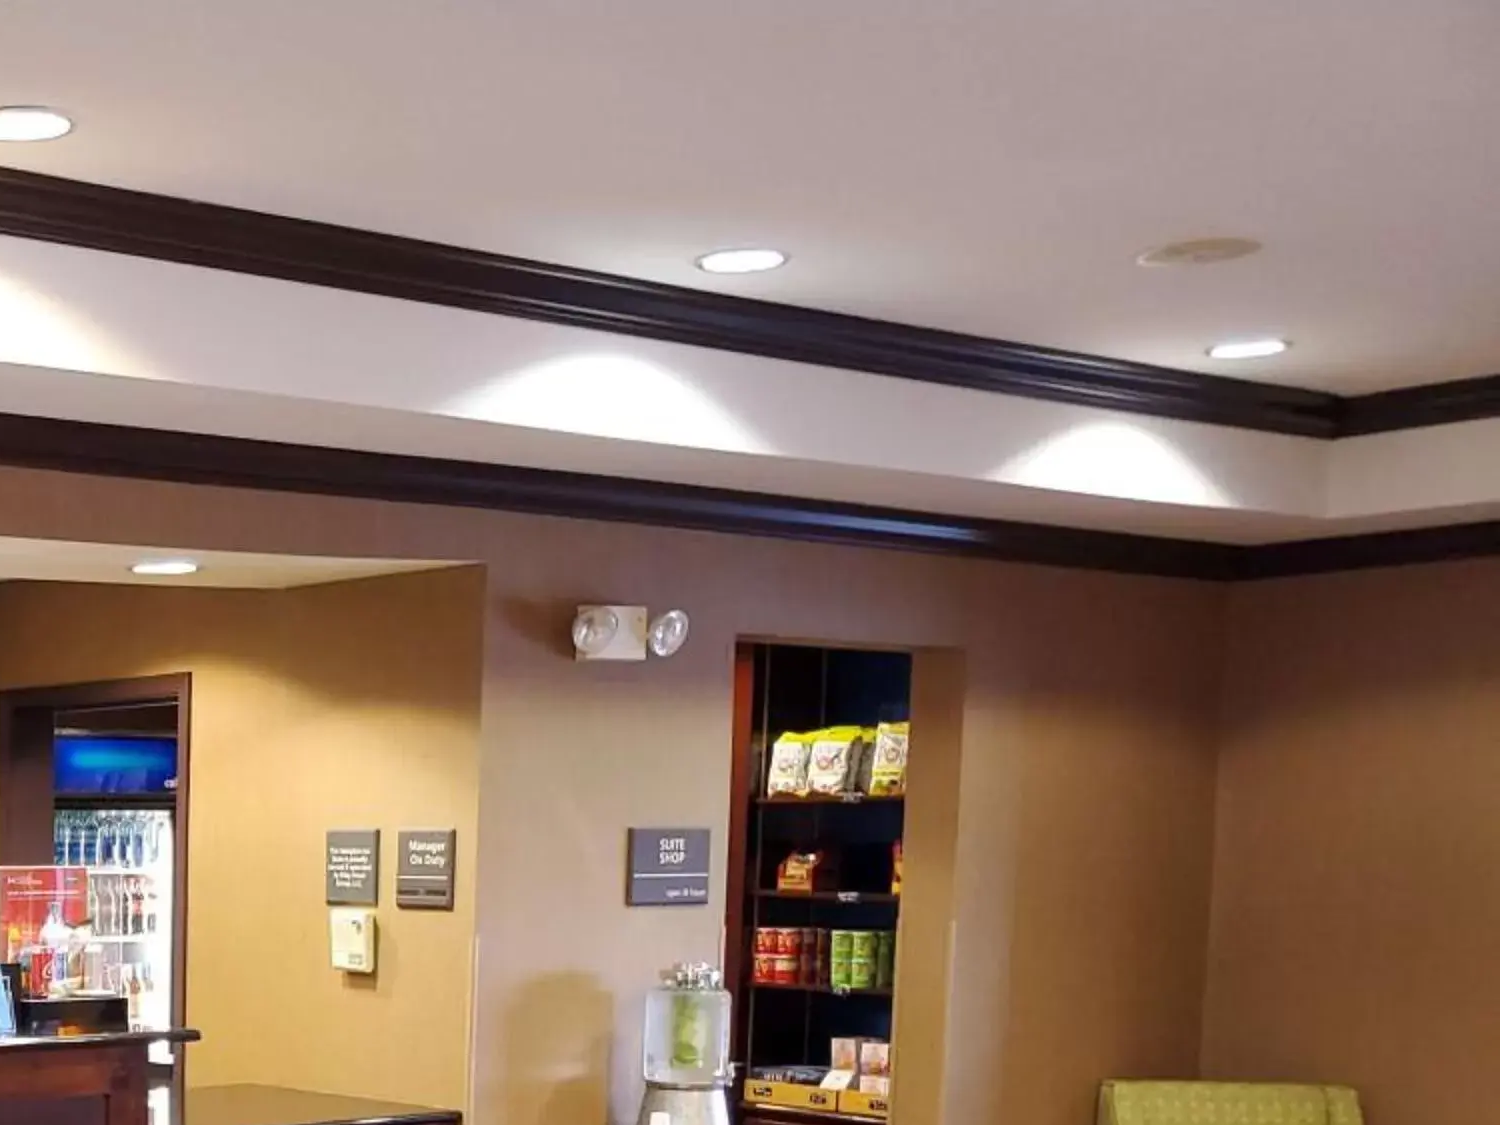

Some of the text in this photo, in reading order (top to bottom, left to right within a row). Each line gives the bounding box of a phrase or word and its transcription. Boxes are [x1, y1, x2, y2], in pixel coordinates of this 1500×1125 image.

[409, 840, 446, 854] Manager
[659, 838, 685, 850] SUITE
[409, 855, 445, 869] On Duty
[659, 851, 685, 864] SHOP
